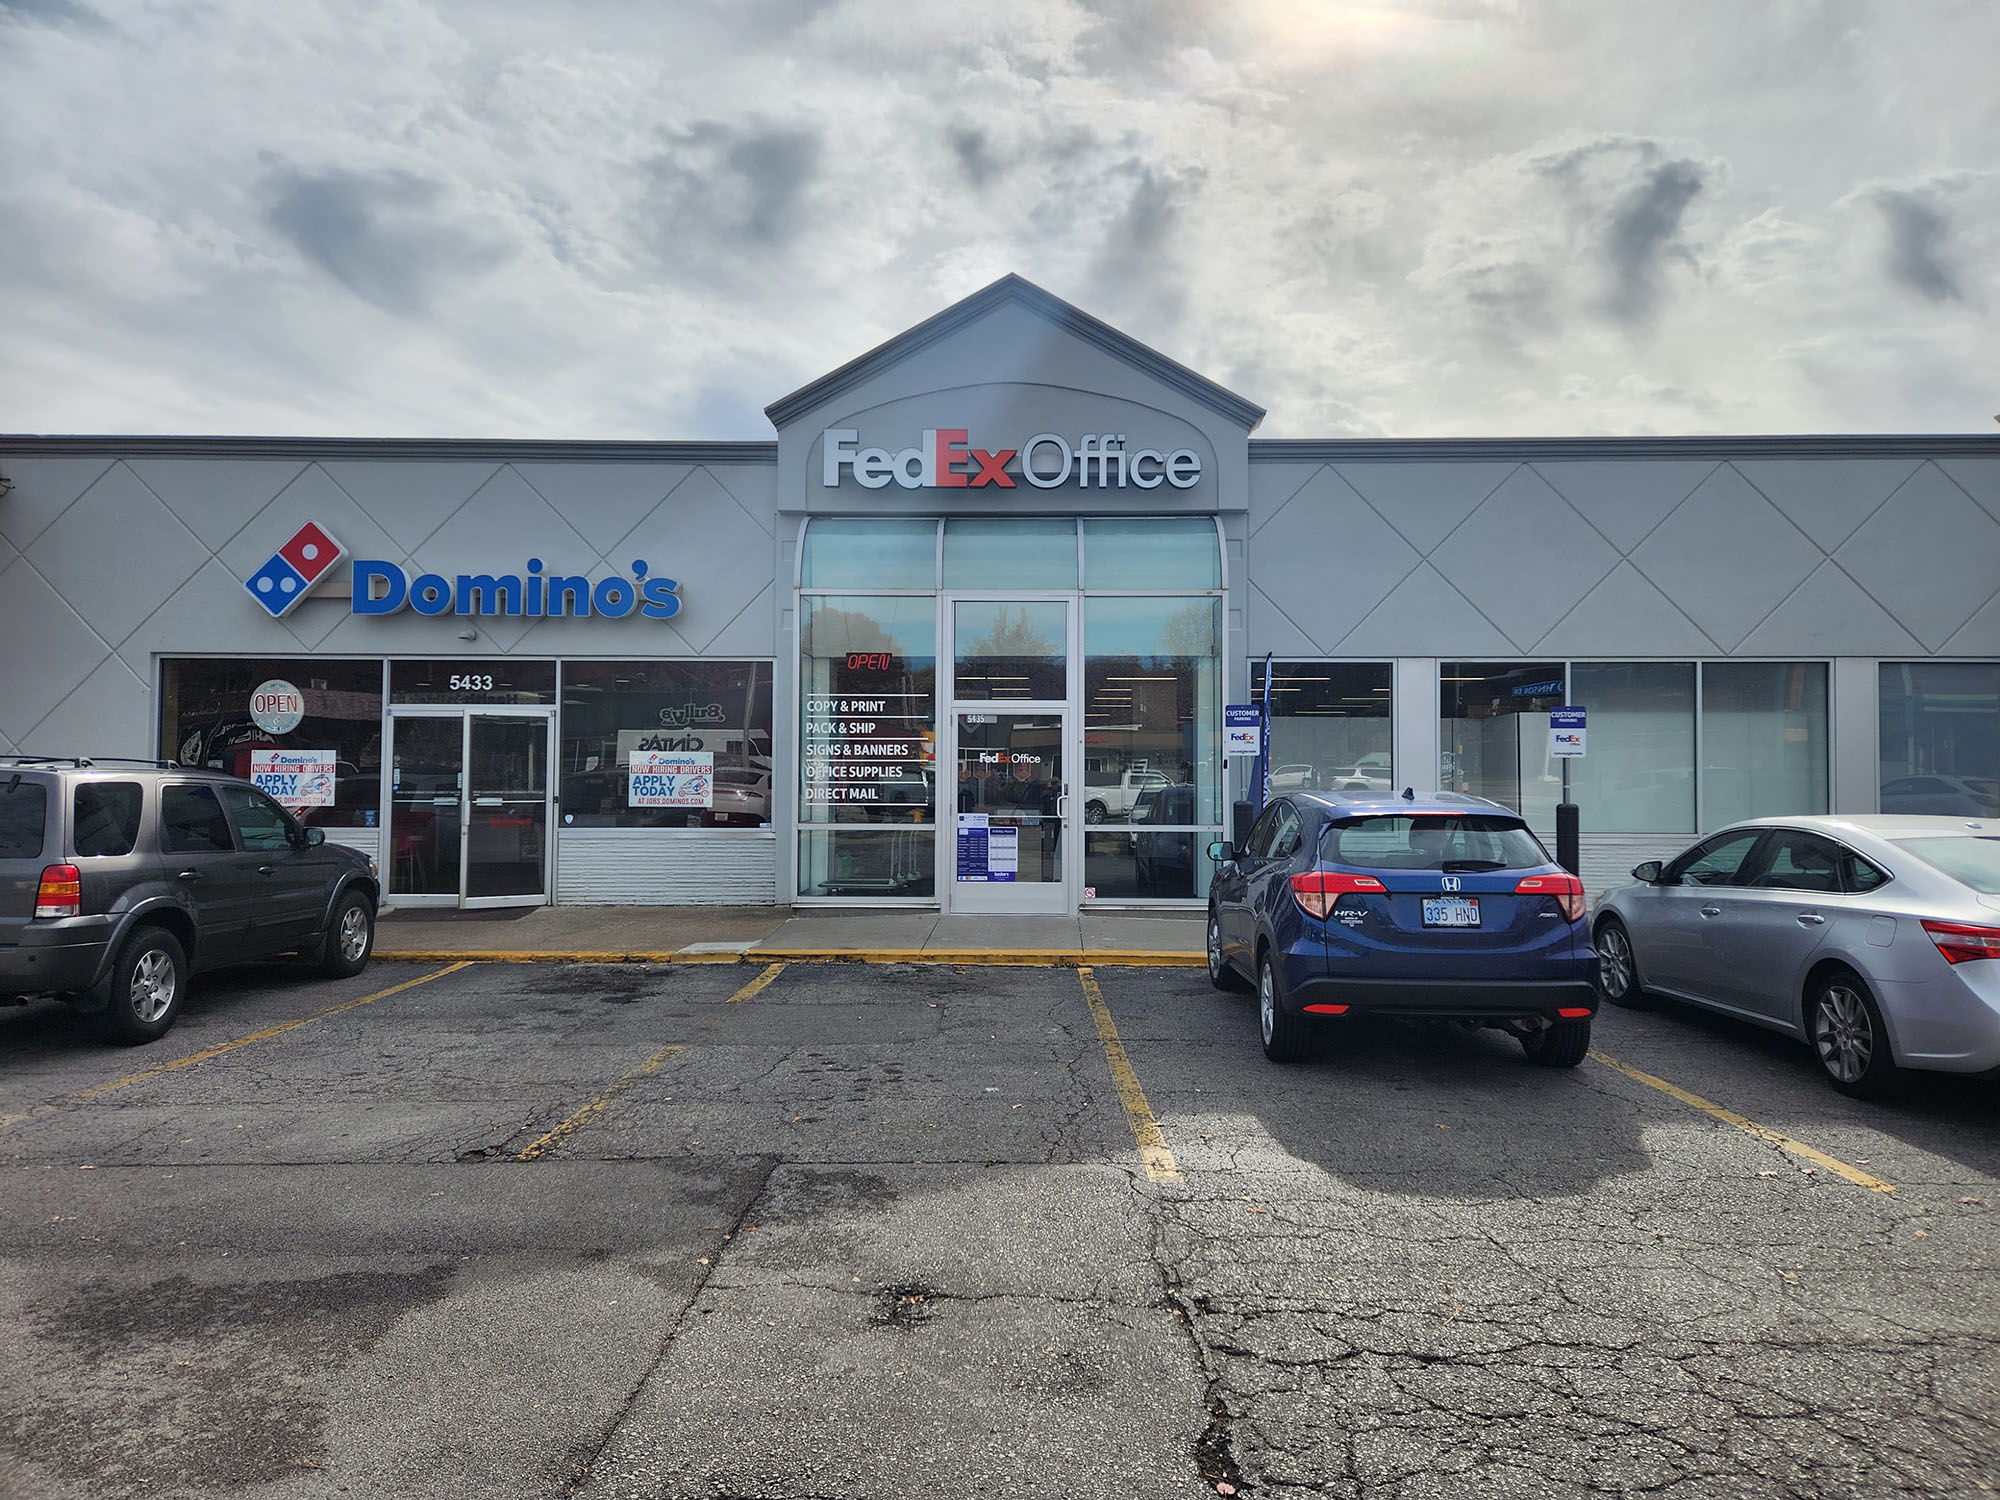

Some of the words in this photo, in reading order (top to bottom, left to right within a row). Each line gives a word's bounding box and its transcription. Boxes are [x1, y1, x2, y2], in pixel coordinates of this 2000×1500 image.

[823, 428, 1018, 489] FedEx
[1021, 432, 1202, 489] Office
[351, 557, 683, 620] Domino's
[847, 653, 891, 671] OPEN
[449, 675, 493, 690] 5433
[254, 693, 298, 714] OPEN
[806, 700, 839, 712] COPY
[840, 700, 849, 712] &
[851, 700, 886, 712] PRINT
[967, 715, 985, 723] 5435
[806, 722, 837, 734] PACK
[838, 722, 847, 734] &
[849, 722, 876, 734] SHIP
[1230, 733, 1255, 741] FedEx
[1555, 734, 1581, 743] FedEx
[806, 744, 841, 756] SIGNS
[843, 744, 852, 756] &
[854, 744, 909, 756] BANNERS
[280, 756, 318, 764] Domino's
[658, 757, 696, 765] Domino's
[979, 752, 1011, 763] FedEx
[1011, 753, 1041, 763] Office
[253, 764, 273, 773] NOW
[274, 764, 300, 773] HIRING
[302, 764, 333, 773] DRIVERS
[631, 765, 650, 774] NOW
[652, 765, 678, 774] HIRING
[680, 765, 711, 774] DRIVERS
[806, 766, 847, 778] OFFICE
[848, 766, 903, 778] SUPPLIES
[254, 774, 298, 785] APPLY
[632, 775, 676, 786] APPLY
[259, 785, 298, 795] ODAY
[632, 786, 675, 796] TODAY
[806, 788, 848, 799] DIRECT
[849, 788, 879, 799] MAIL
[637, 797, 645, 805] AT
[646, 797, 704, 805] JOBS.DOMINOS.COM
[1425, 907, 1448, 921] 335
[1455, 907, 1478, 922] HND
